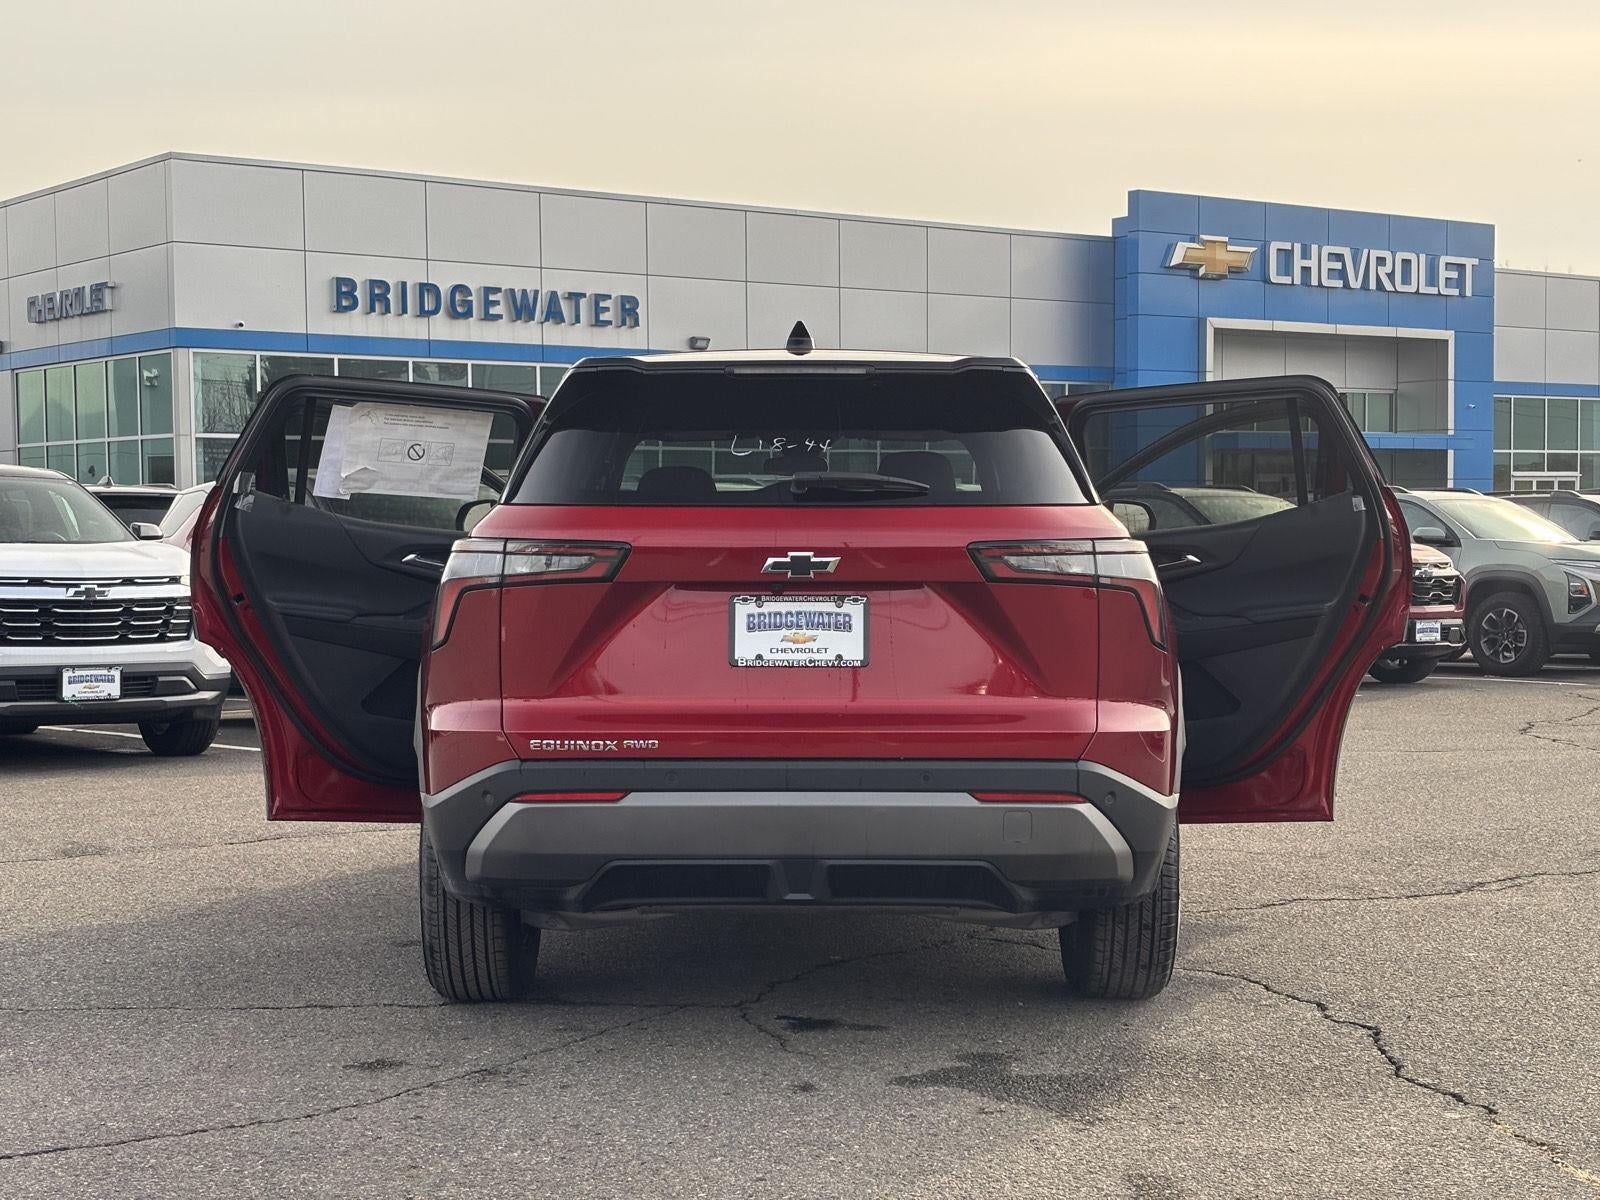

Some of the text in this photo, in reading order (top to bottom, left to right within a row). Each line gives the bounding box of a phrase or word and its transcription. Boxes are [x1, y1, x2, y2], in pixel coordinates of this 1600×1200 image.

[1267, 240, 1480, 297] CHEVROLET
[27, 281, 115, 323] CHEVROLET
[330, 275, 641, 329] BRIDGEWATER
[746, 610, 853, 633] BRIDGEWATER
[529, 739, 659, 752] EQUINOX AWD
